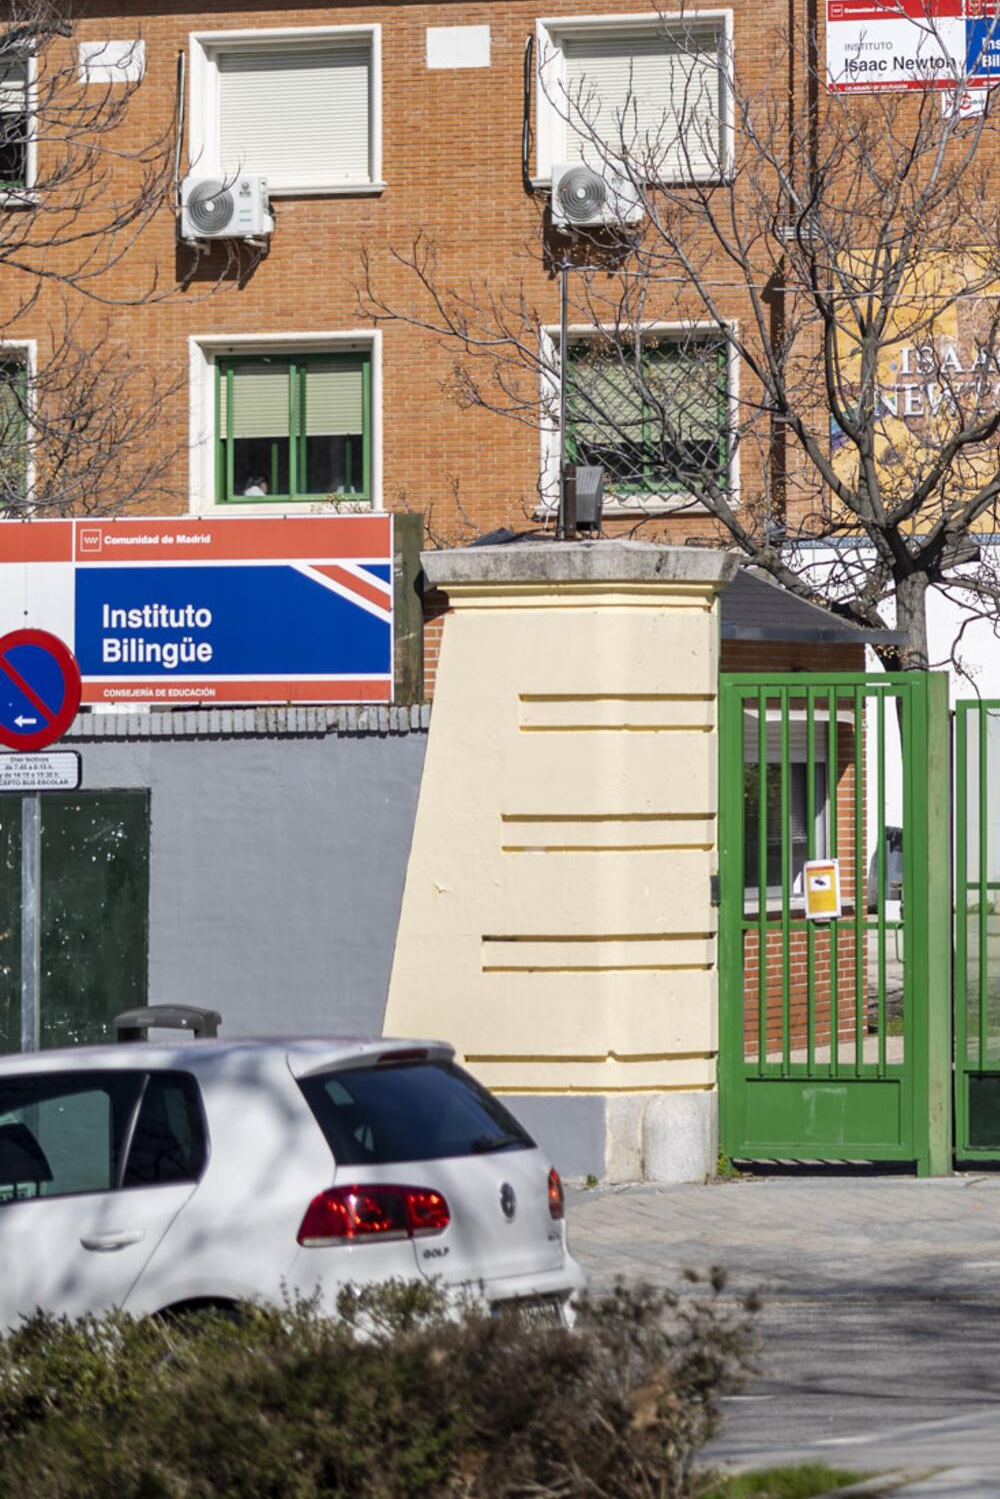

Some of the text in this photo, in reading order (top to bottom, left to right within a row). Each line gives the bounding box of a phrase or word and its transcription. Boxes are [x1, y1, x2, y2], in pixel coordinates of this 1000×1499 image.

[844, 41, 894, 52] INSTITUTO
[844, 55, 957, 73] Isaac Newton
[104, 533, 212, 545] Comunidad de Madrid
[102, 603, 213, 629] Instituto
[102, 636, 214, 669] Bilingüe
[103, 686, 216, 698] CONSEJERÍA DE EDUCACIÓN
